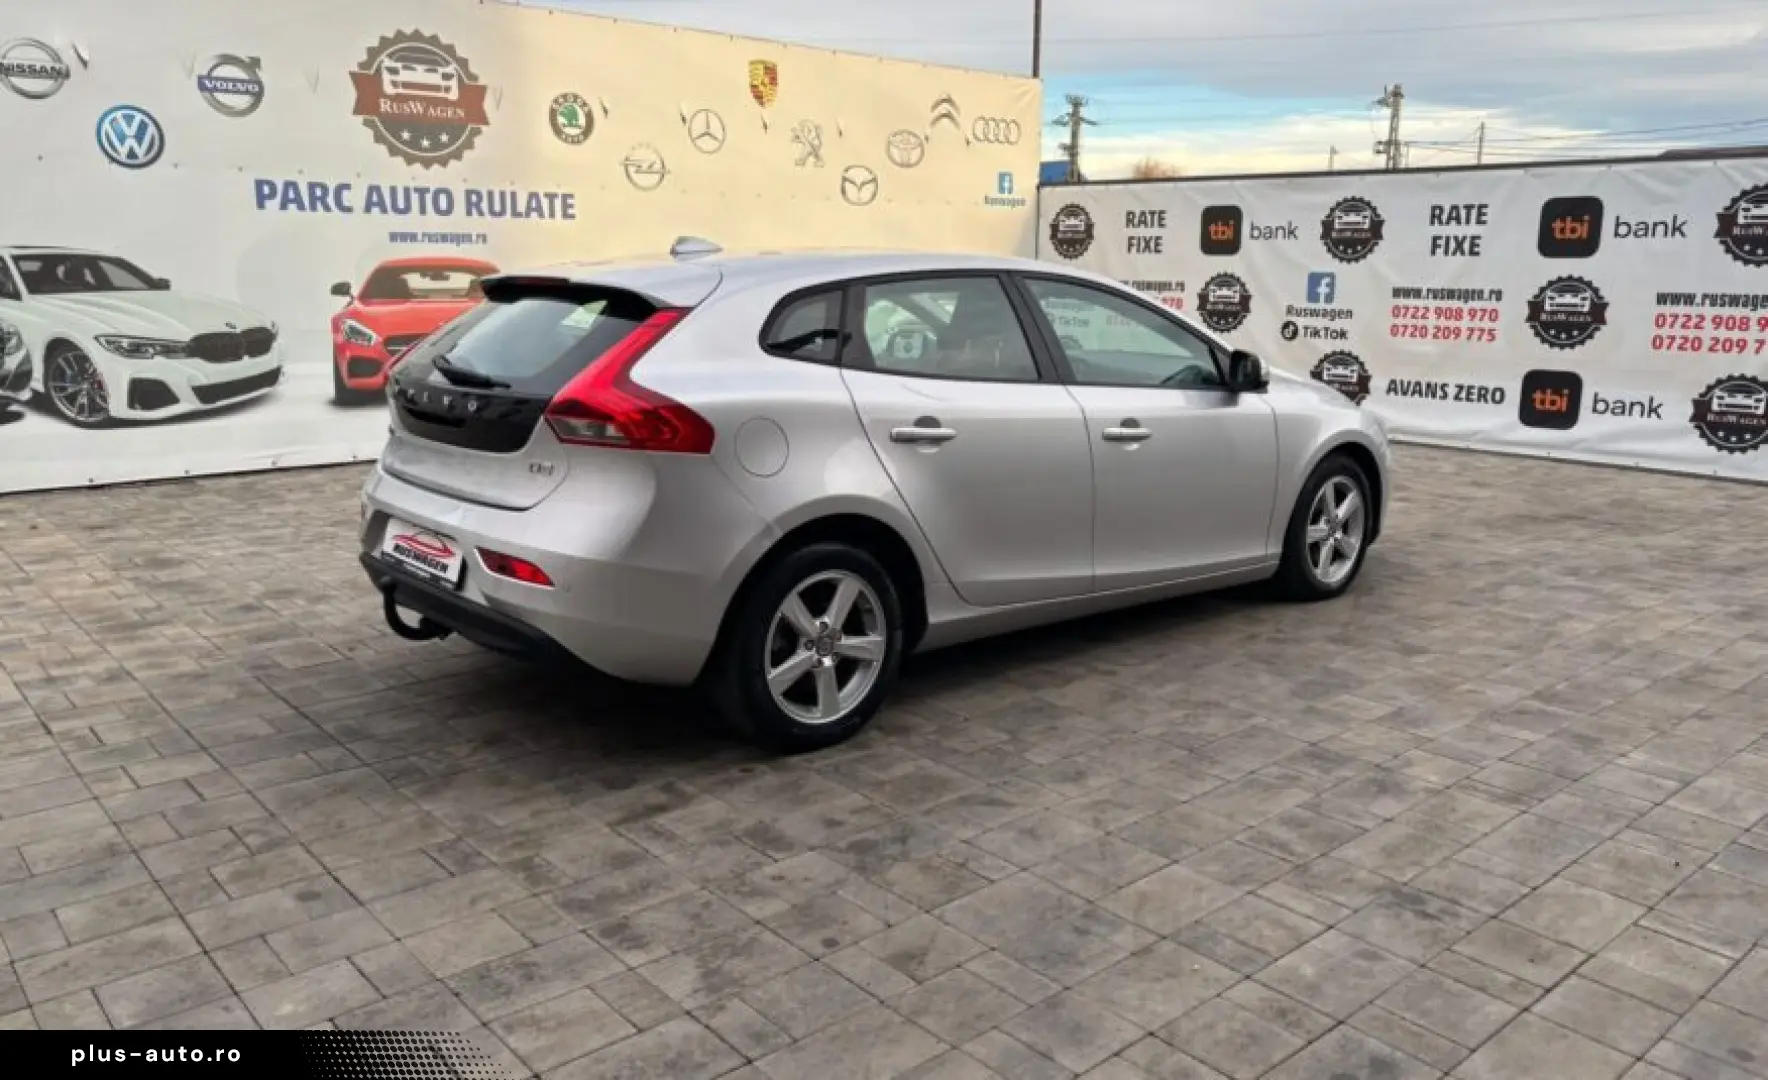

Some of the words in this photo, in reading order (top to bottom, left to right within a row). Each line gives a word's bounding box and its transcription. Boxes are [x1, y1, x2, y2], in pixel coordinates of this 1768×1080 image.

[204, 80, 261, 92] VOLVO
[254, 179, 353, 213] PARC
[363, 184, 455, 217] AUTO
[465, 189, 577, 220] RULATE
[1125, 209, 1167, 229] RATE
[1429, 203, 1489, 227] RATE
[1208, 220, 1235, 241] tbi
[1249, 221, 1299, 242] bank
[1551, 215, 1590, 240] tbi
[1613, 214, 1688, 239] bank
[1127, 235, 1163, 254] FIXE
[1430, 235, 1482, 257] FIXE
[1392, 287, 1502, 304] www.ruswagen.ro
[1285, 304, 1354, 321] Ruswagen
[1391, 304, 1430, 320] 0722
[1434, 306, 1464, 321] 908
[1468, 308, 1499, 323] 970
[1654, 313, 1706, 330] 0722
[1710, 314, 1751, 332] 908
[1302, 325, 1349, 340] TikTok
[1389, 323, 1428, 339] 0720
[1433, 325, 1462, 340] 209
[1466, 326, 1497, 342] 775
[1652, 335, 1702, 352] 0720
[1707, 336, 1748, 355] 209
[1385, 379, 1449, 401] AVANS
[1454, 383, 1507, 405] ZERO
[1531, 389, 1569, 411] tbi
[1591, 392, 1664, 419] bank
